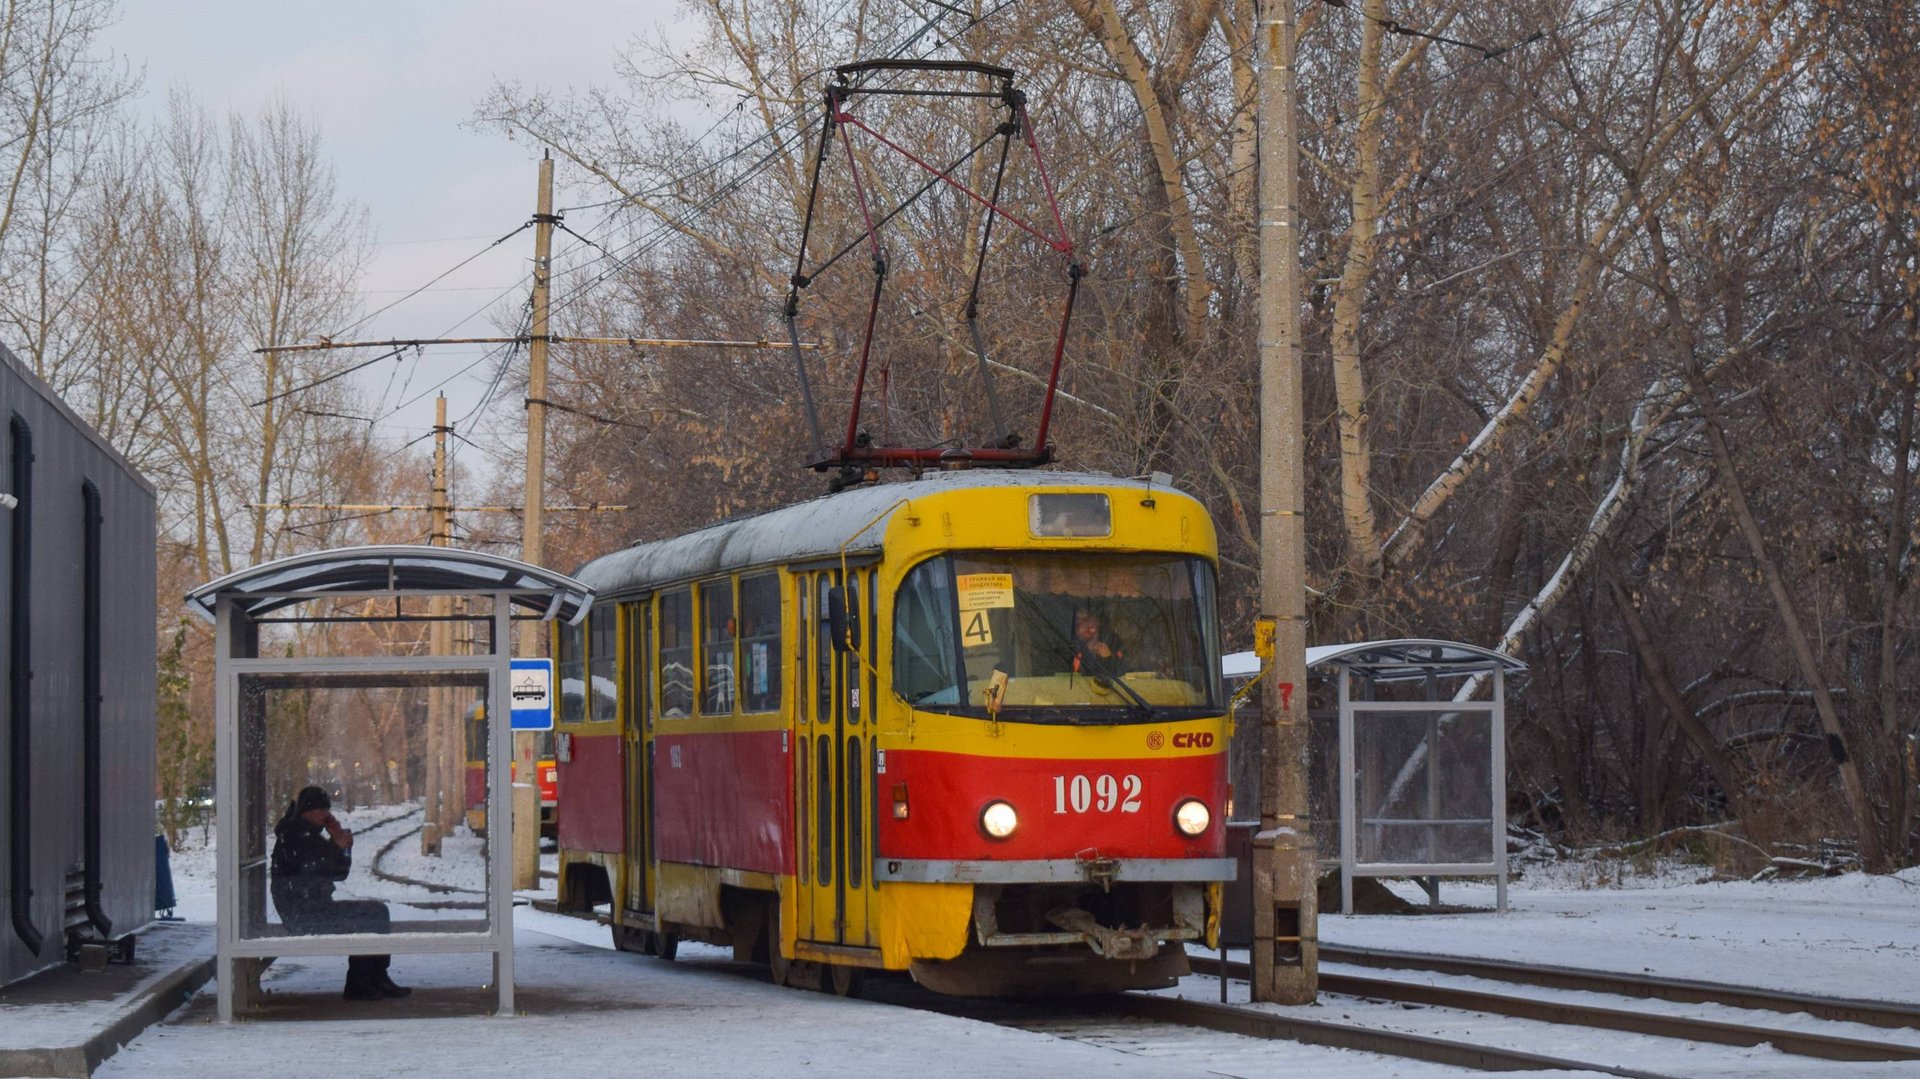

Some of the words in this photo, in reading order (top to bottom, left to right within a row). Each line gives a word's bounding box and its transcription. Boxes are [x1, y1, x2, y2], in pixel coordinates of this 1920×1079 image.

[965, 611, 989, 642] 4
[1278, 683, 1294, 711] 7
[1053, 774, 1142, 814] 1092
